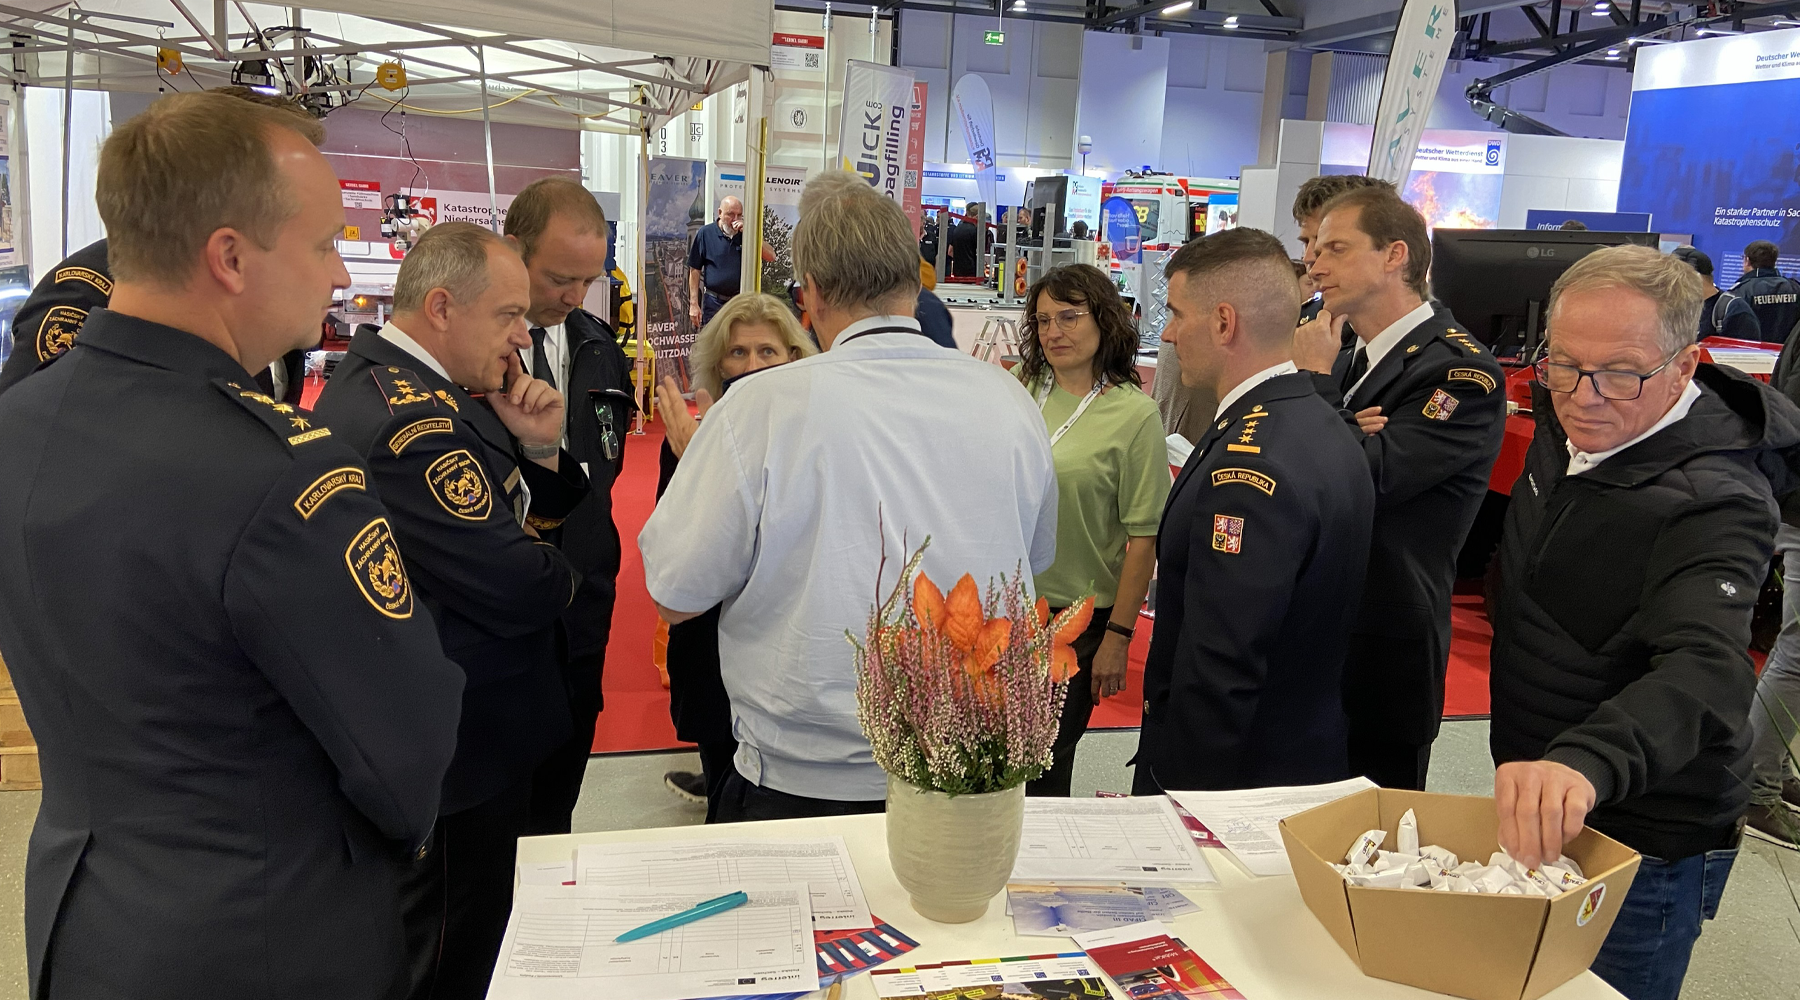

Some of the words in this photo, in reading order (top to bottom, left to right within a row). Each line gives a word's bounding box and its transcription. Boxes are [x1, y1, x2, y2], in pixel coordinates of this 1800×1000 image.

[1756, 53, 1788, 62] Deutscher
[1446, 149, 1484, 157] Wetterdienst
[650, 173, 688, 182] EAVER
[1714, 207, 1726, 216] Ein
[1726, 207, 1751, 216] starker
[1751, 207, 1778, 217] Partner
[1778, 208, 1786, 216] in
[1713, 217, 1781, 227] Katastrophenschutz
[1216, 470, 1236, 481] ČESKÁ
[1237, 471, 1270, 490] REPUBLIKA
[303, 473, 347, 510] KARLOVARSKÝ
[348, 474, 362, 484] KRAJ
